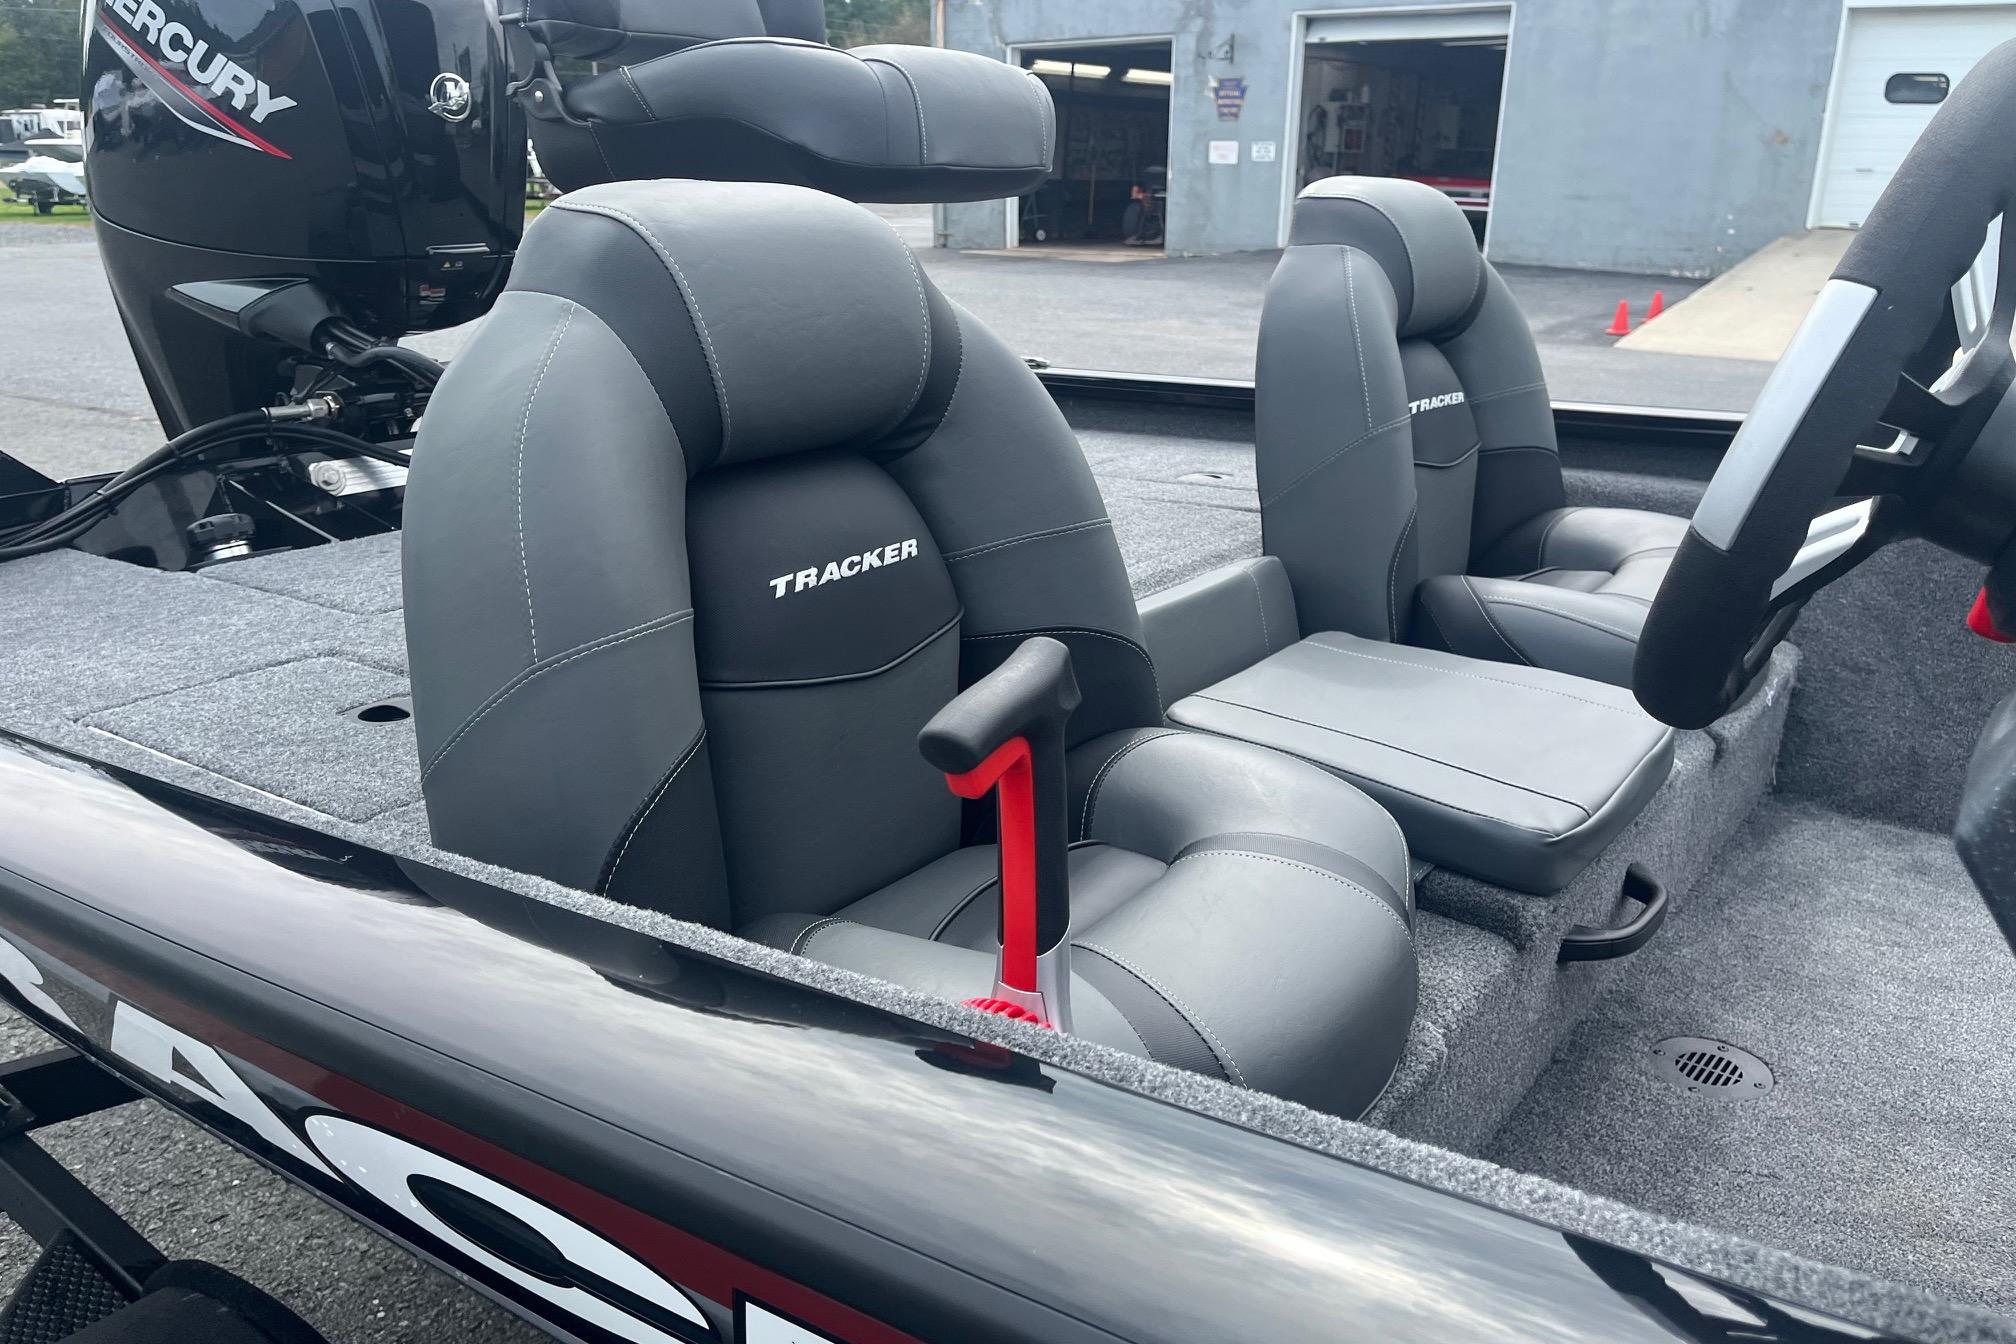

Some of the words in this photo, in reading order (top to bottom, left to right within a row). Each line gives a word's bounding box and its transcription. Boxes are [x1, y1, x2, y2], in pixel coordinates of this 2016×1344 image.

[105, 0, 298, 124] ERCURY
[1408, 391, 1465, 415] TRACKER
[769, 538, 918, 599] TRACKER
